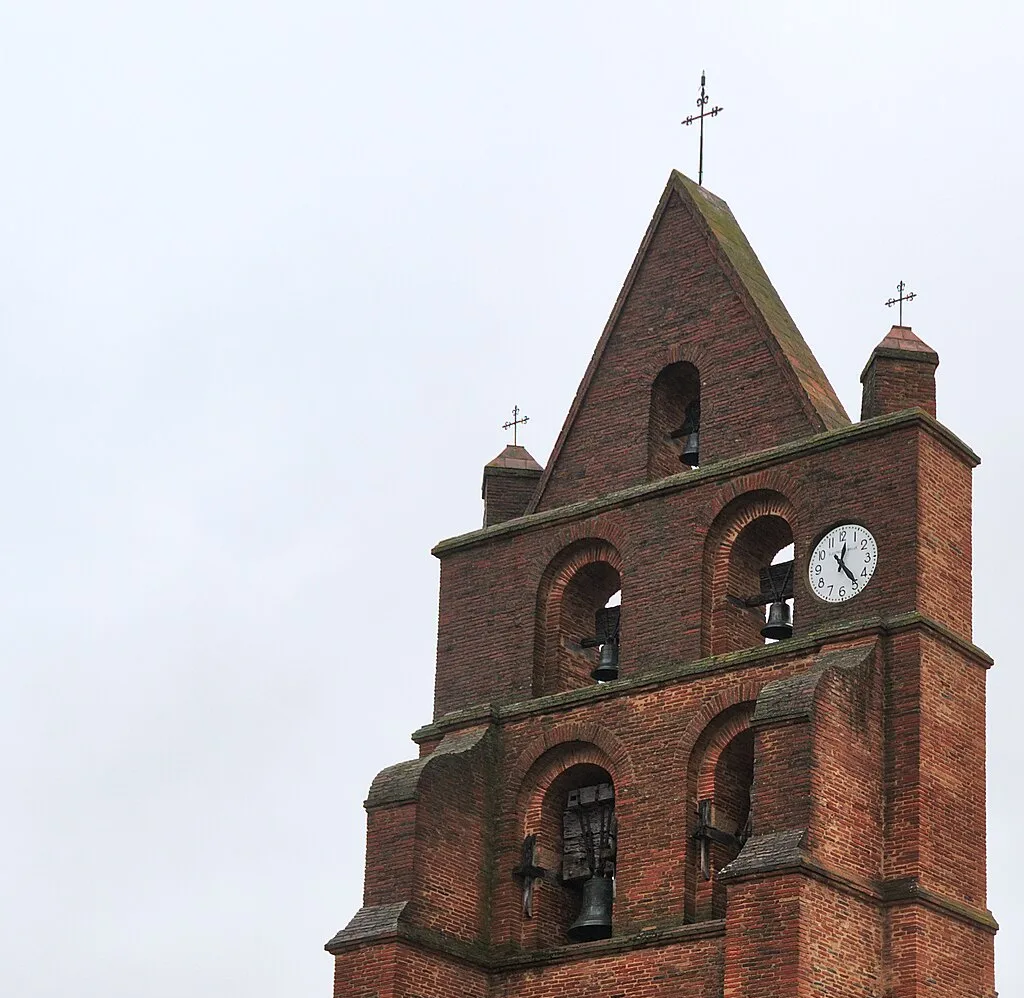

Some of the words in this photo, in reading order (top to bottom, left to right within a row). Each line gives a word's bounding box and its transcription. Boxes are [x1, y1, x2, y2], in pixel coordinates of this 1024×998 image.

[839, 531, 847, 542] 12
[828, 538, 834, 548] 11
[861, 539, 868, 550] 2
[818, 550, 826, 561] 10
[864, 553, 871, 563] 3
[815, 565, 822, 575] 9
[861, 567, 867, 577] 4
[818, 578, 824, 588] 8
[852, 579, 858, 590] 5
[827, 585, 833, 596] 7
[839, 586, 846, 596] 6
